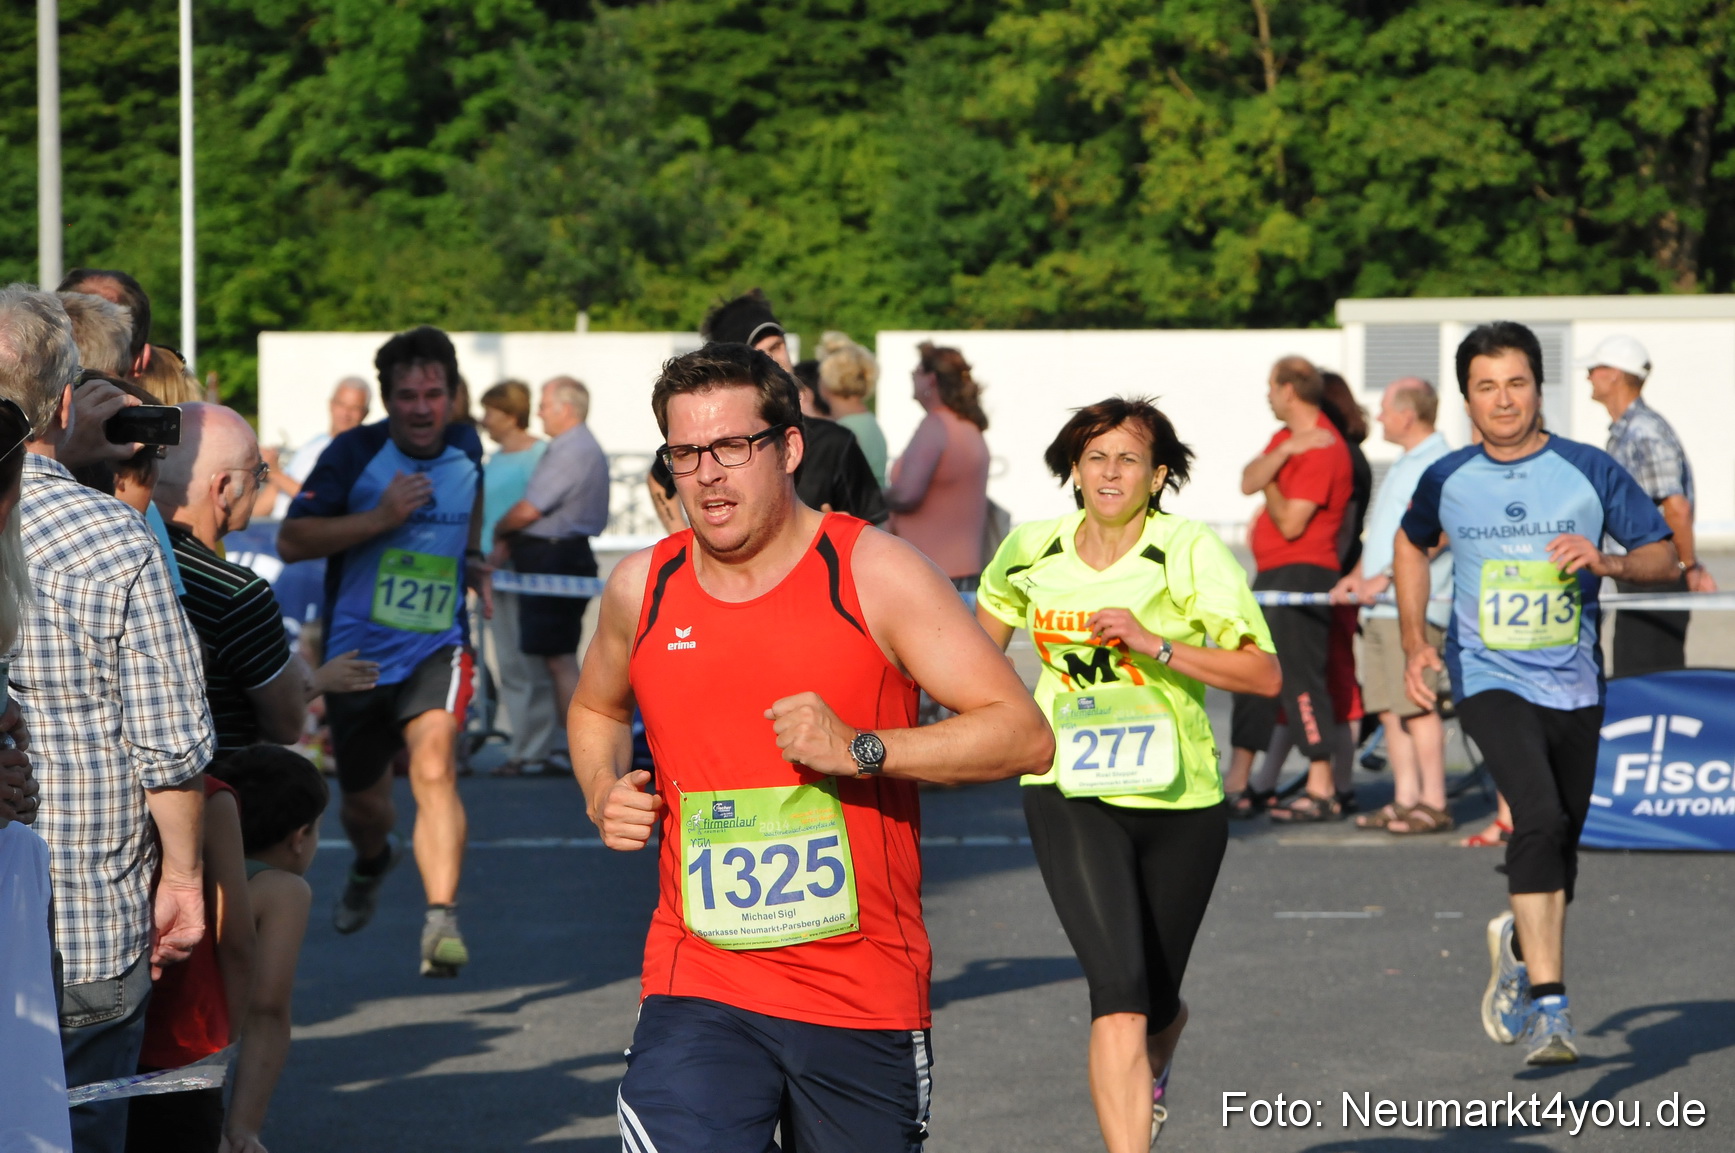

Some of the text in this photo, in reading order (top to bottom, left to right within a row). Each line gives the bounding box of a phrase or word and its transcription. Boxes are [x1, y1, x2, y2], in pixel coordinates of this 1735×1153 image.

[379, 575, 453, 614] 1217
[1484, 591, 1576, 627] 1213
[667, 640, 697, 651] erima
[1062, 646, 1121, 689] M
[1072, 724, 1156, 771] 277
[1612, 752, 1735, 796] Fisc
[703, 815, 757, 829] firmenlauf
[759, 818, 790, 833] 2014
[688, 835, 846, 910] 1325
[697, 912, 846, 937] Sparkasse Neumarkt-Parsberg AdöR
[741, 908, 797, 921] Michael Sigl
